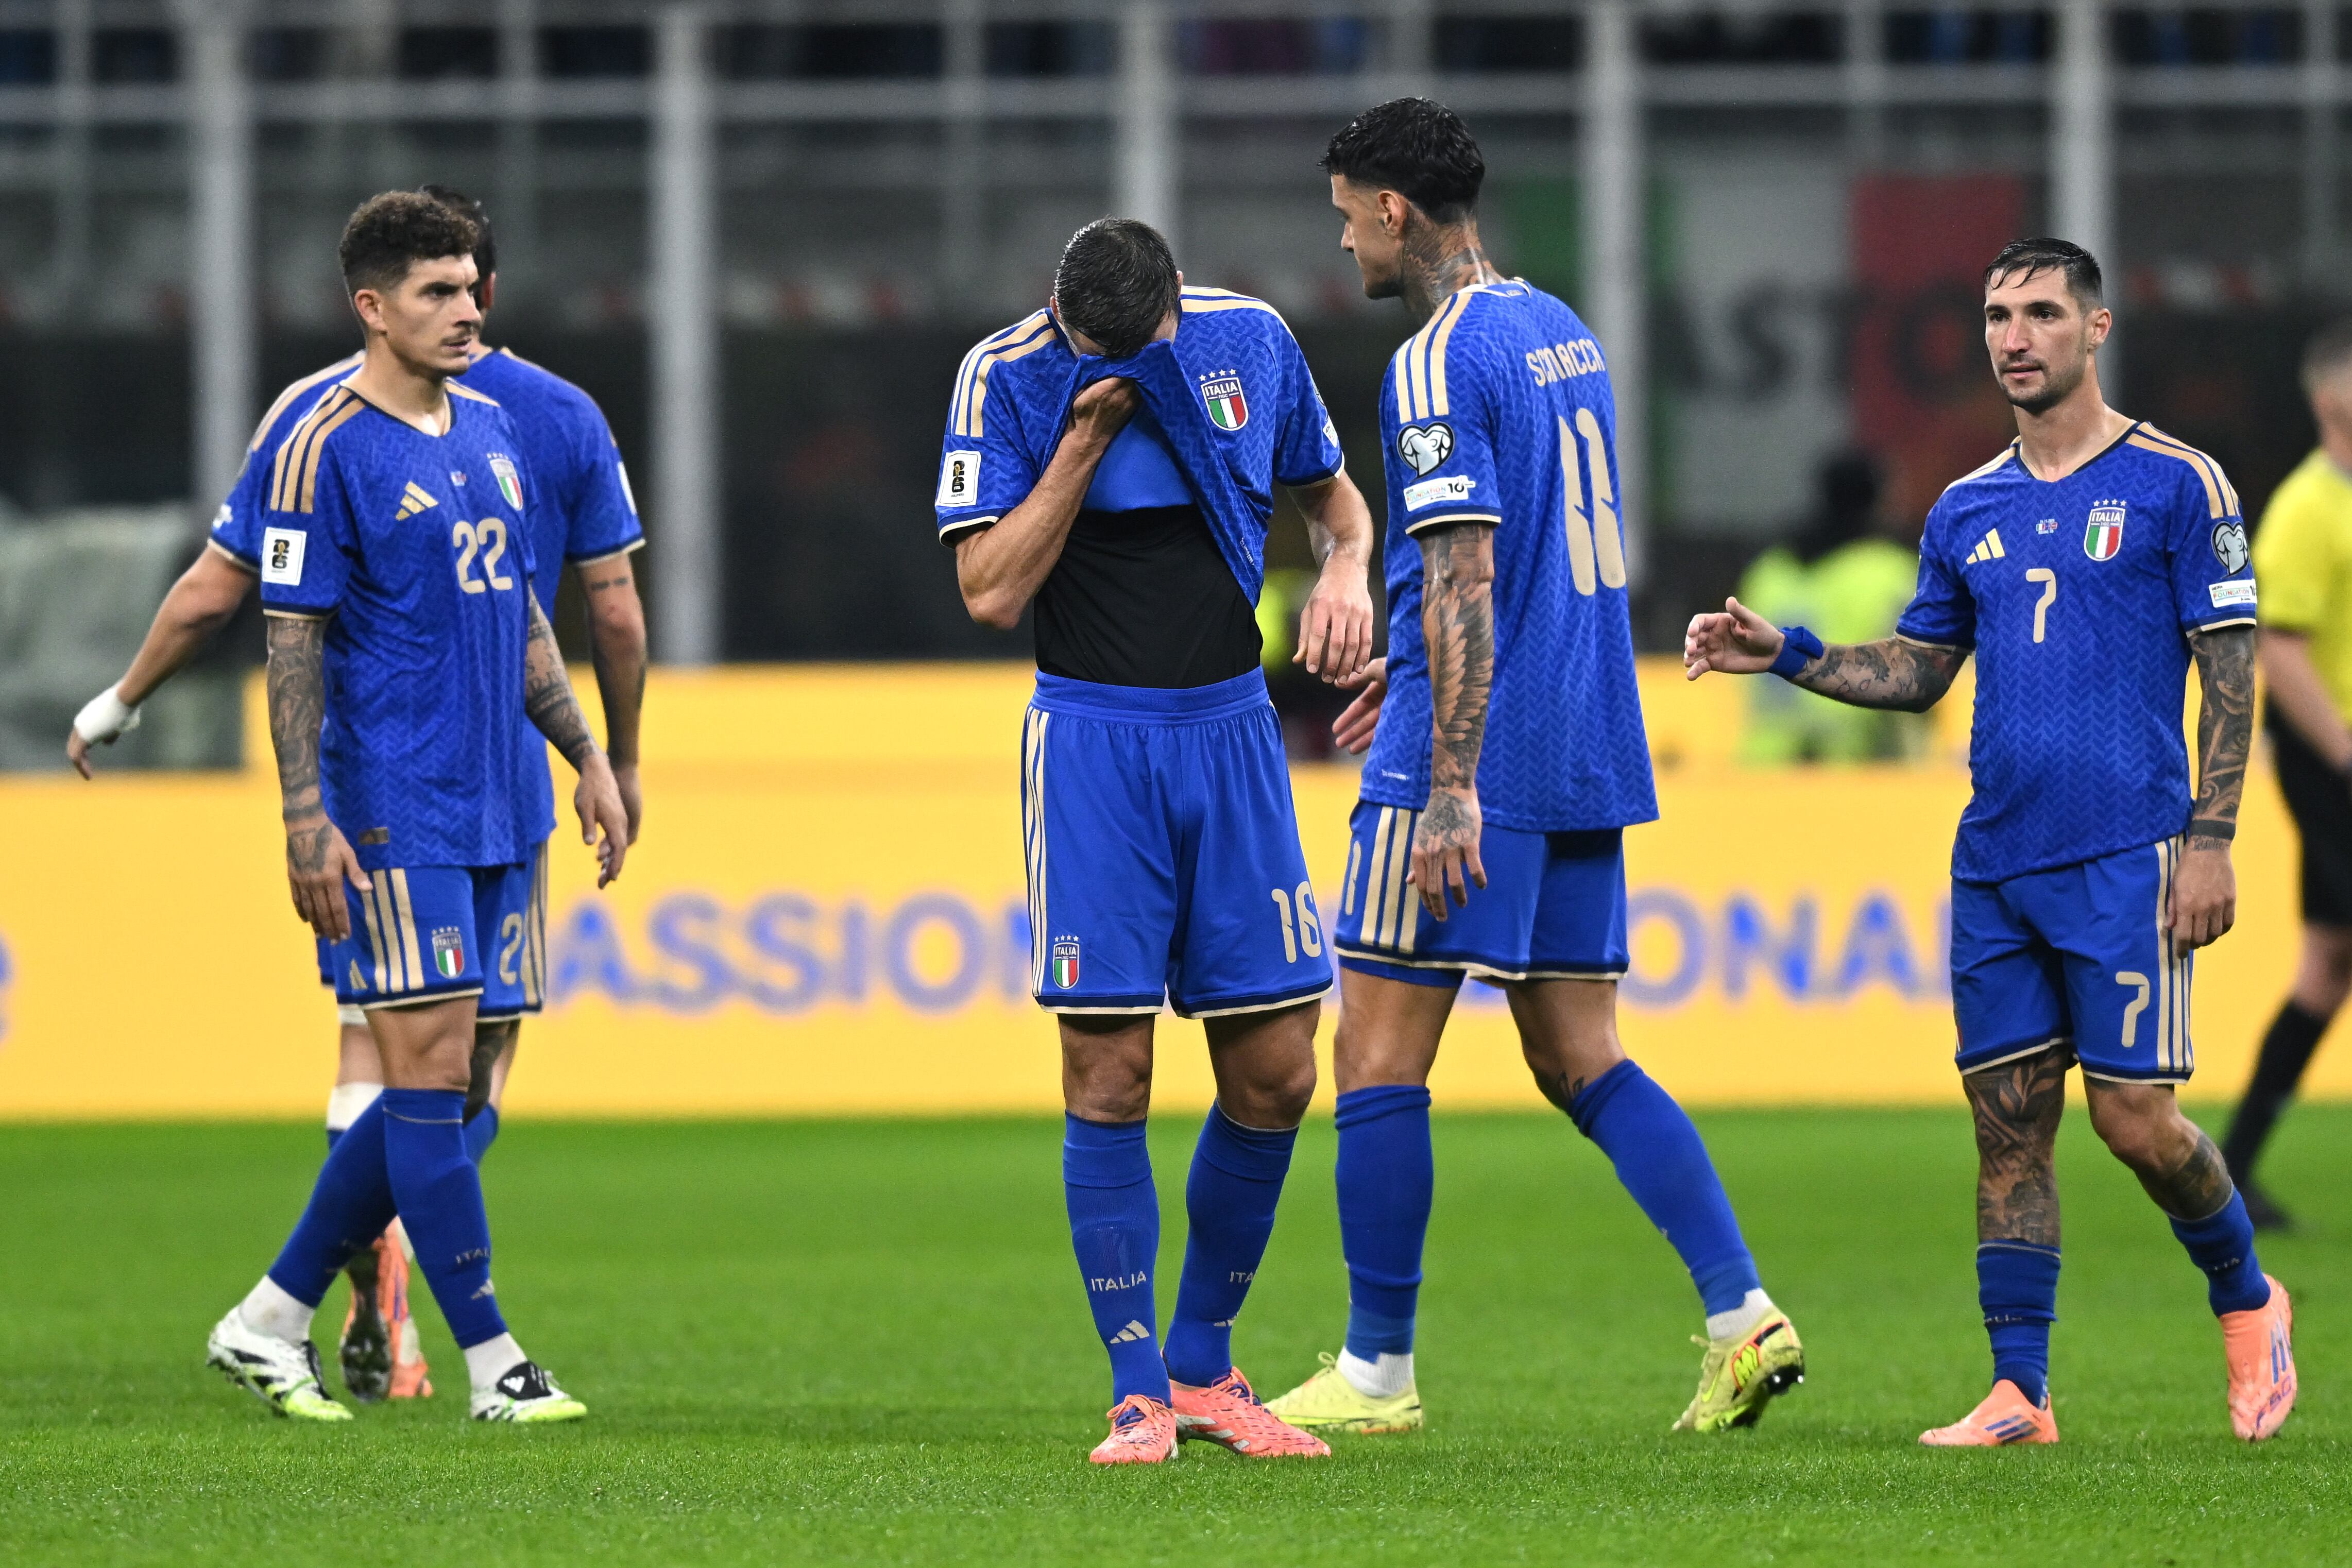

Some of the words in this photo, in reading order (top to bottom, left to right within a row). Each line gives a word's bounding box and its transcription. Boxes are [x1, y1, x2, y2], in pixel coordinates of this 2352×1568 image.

[1204, 382, 1238, 396] ITALIA
[1558, 407, 1626, 596] 11
[2091, 512, 2120, 522] ITALIA
[453, 517, 514, 593] 22
[2025, 568, 2056, 643] 7
[1055, 946, 1077, 956] ITALIA
[1271, 880, 1321, 963] 16
[2115, 972, 2150, 1047] 7
[1090, 1270, 1147, 1292] ITALIA
